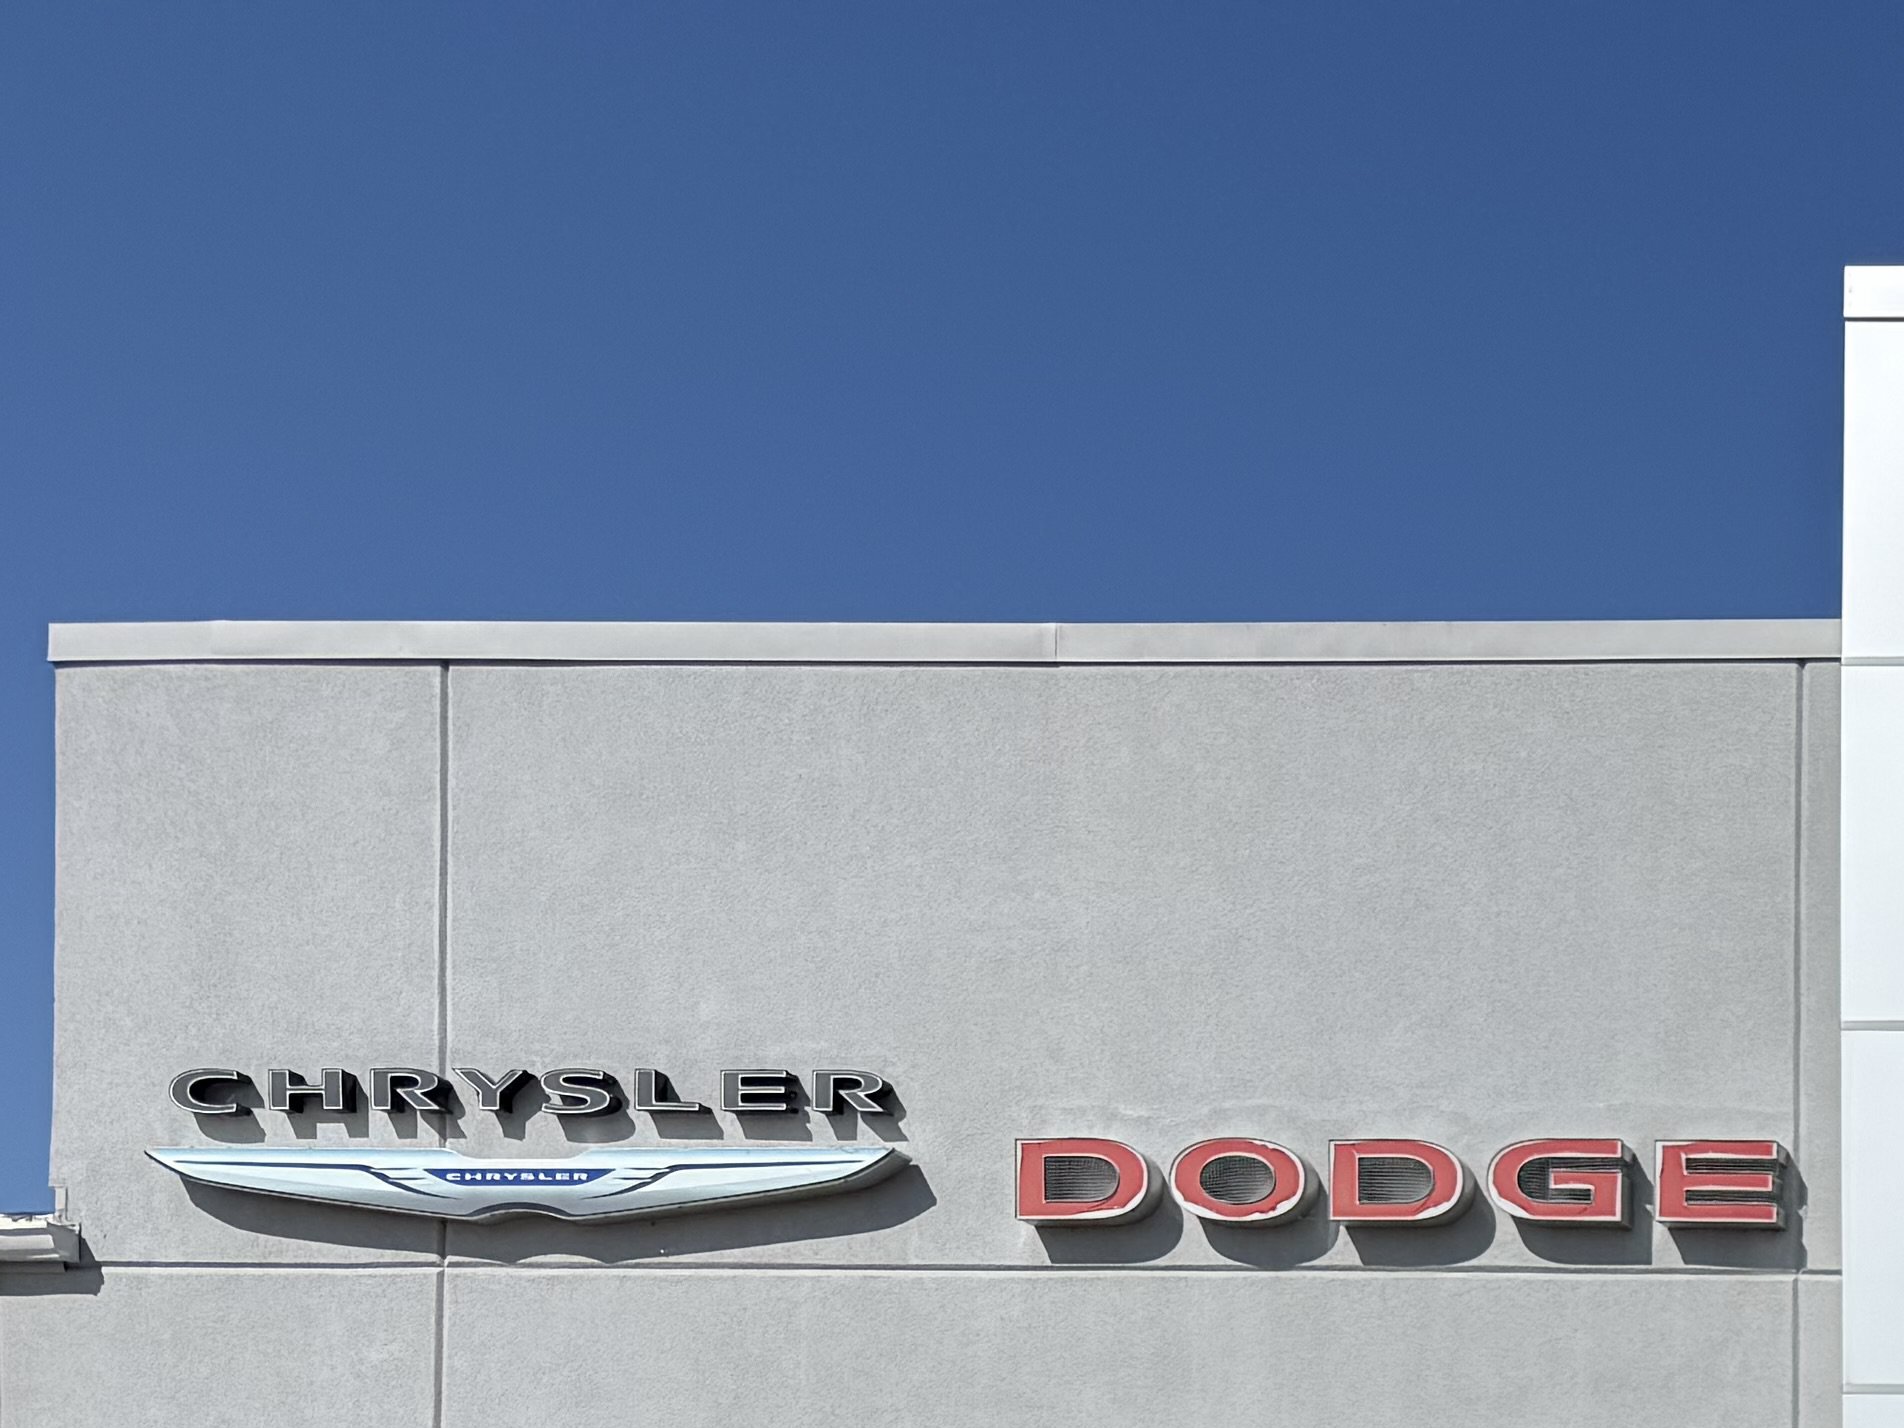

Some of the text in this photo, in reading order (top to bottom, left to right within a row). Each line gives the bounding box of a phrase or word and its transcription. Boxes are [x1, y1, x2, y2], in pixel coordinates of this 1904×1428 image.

[168, 1067, 890, 1115] CHRYSLER
[446, 1172, 588, 1181] CHRYSLER
[1015, 1138, 1780, 1225] DODGE
